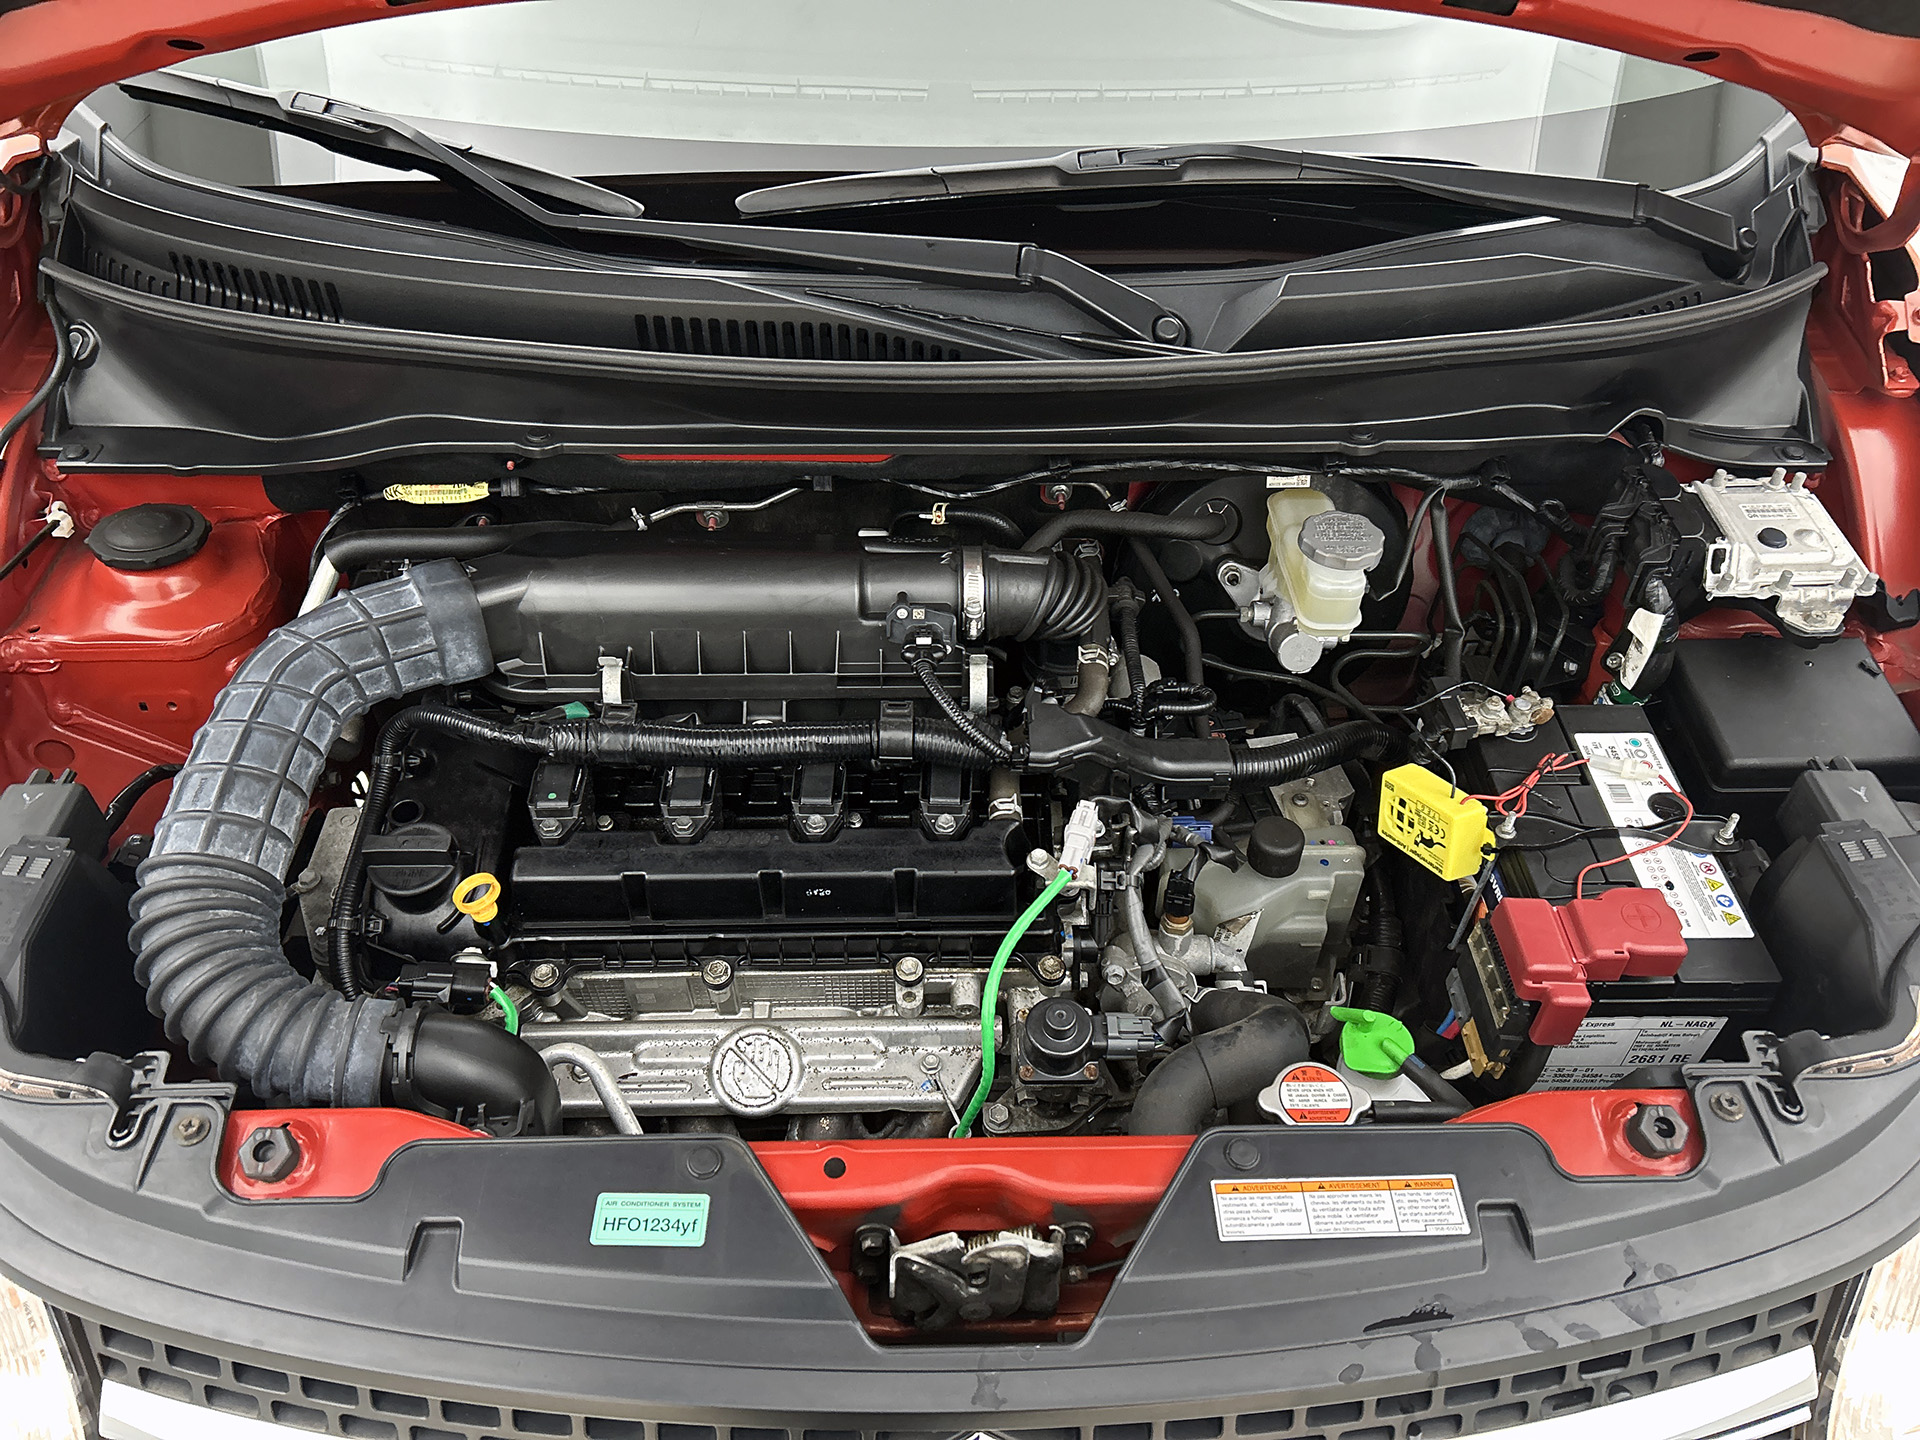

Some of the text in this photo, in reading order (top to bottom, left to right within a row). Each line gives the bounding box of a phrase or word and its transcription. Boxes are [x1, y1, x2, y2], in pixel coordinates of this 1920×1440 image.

[1628, 1054, 1692, 1064] 2681 RE
[603, 1217, 699, 1237] HFO1234yf
